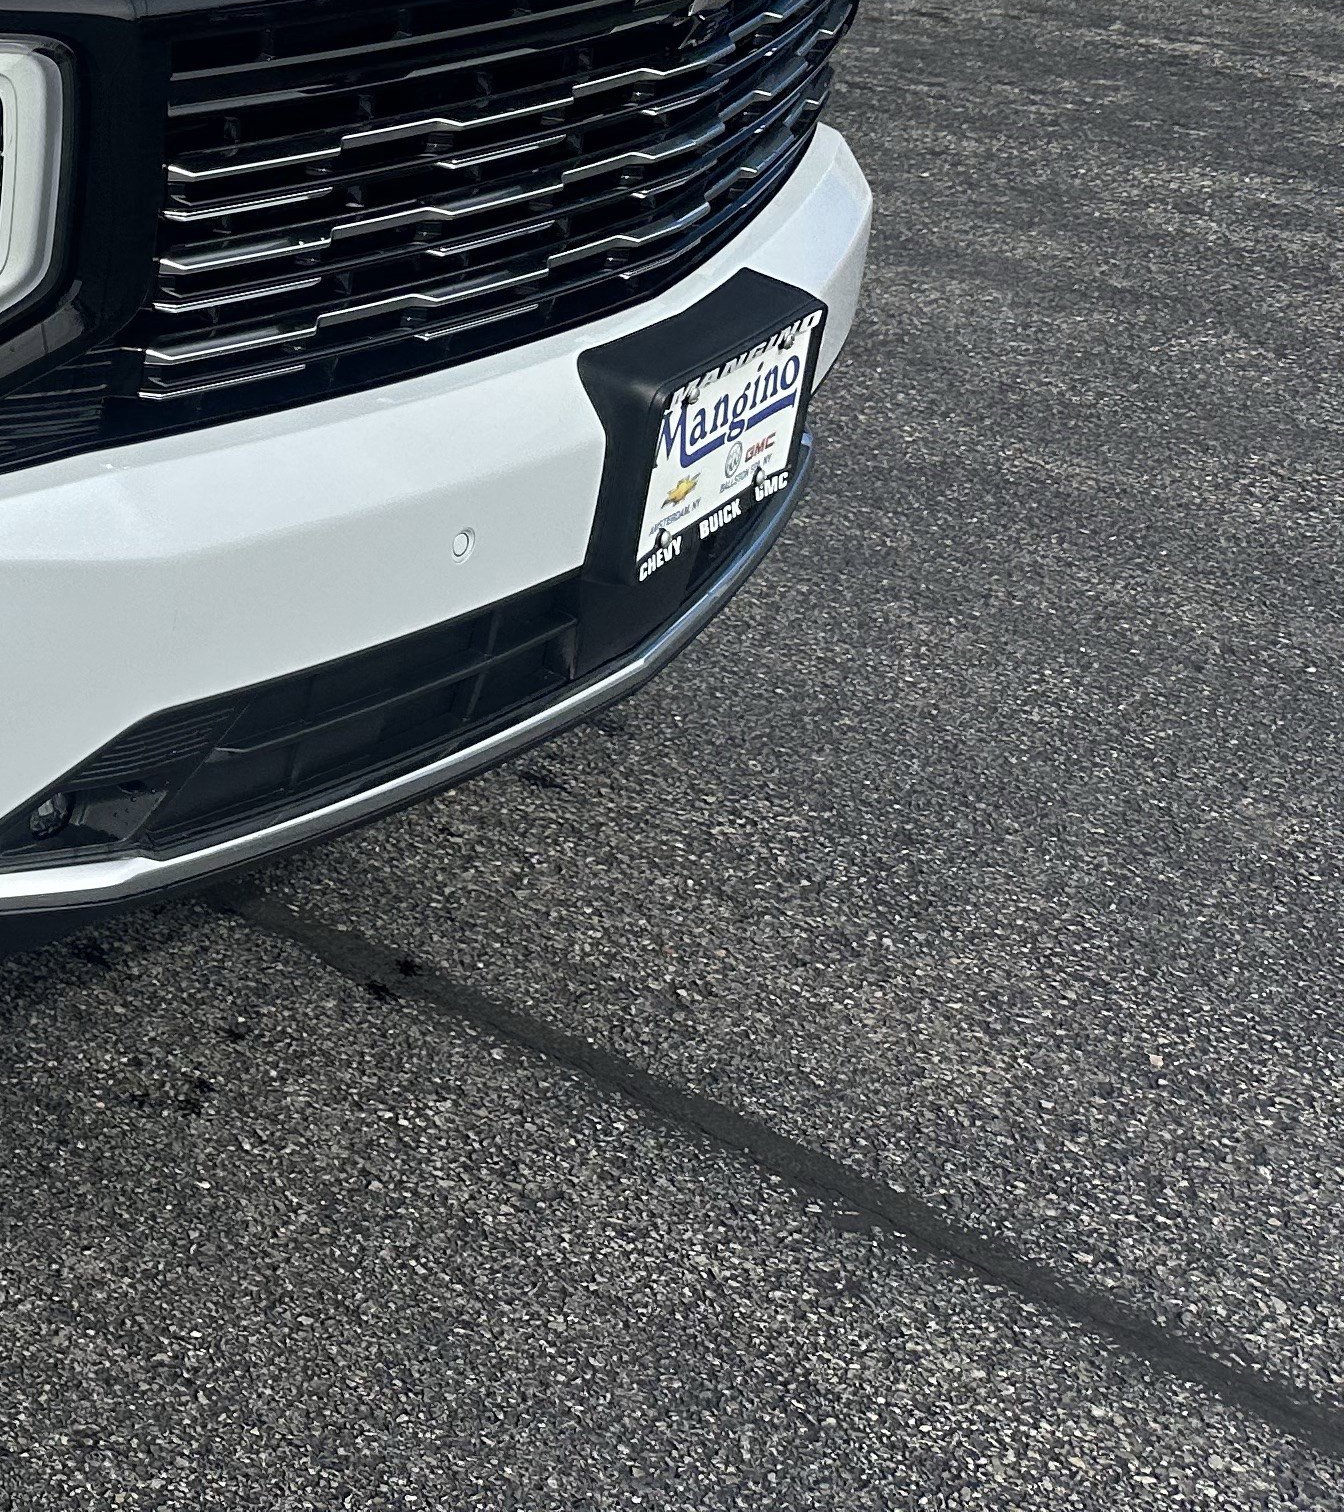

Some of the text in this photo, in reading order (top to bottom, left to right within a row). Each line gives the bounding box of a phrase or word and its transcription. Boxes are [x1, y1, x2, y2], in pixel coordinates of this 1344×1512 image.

[657, 354, 800, 469] Mangino
[745, 432, 776, 463] GMC
[639, 471, 789, 582] CHEVY BUICK GMC
